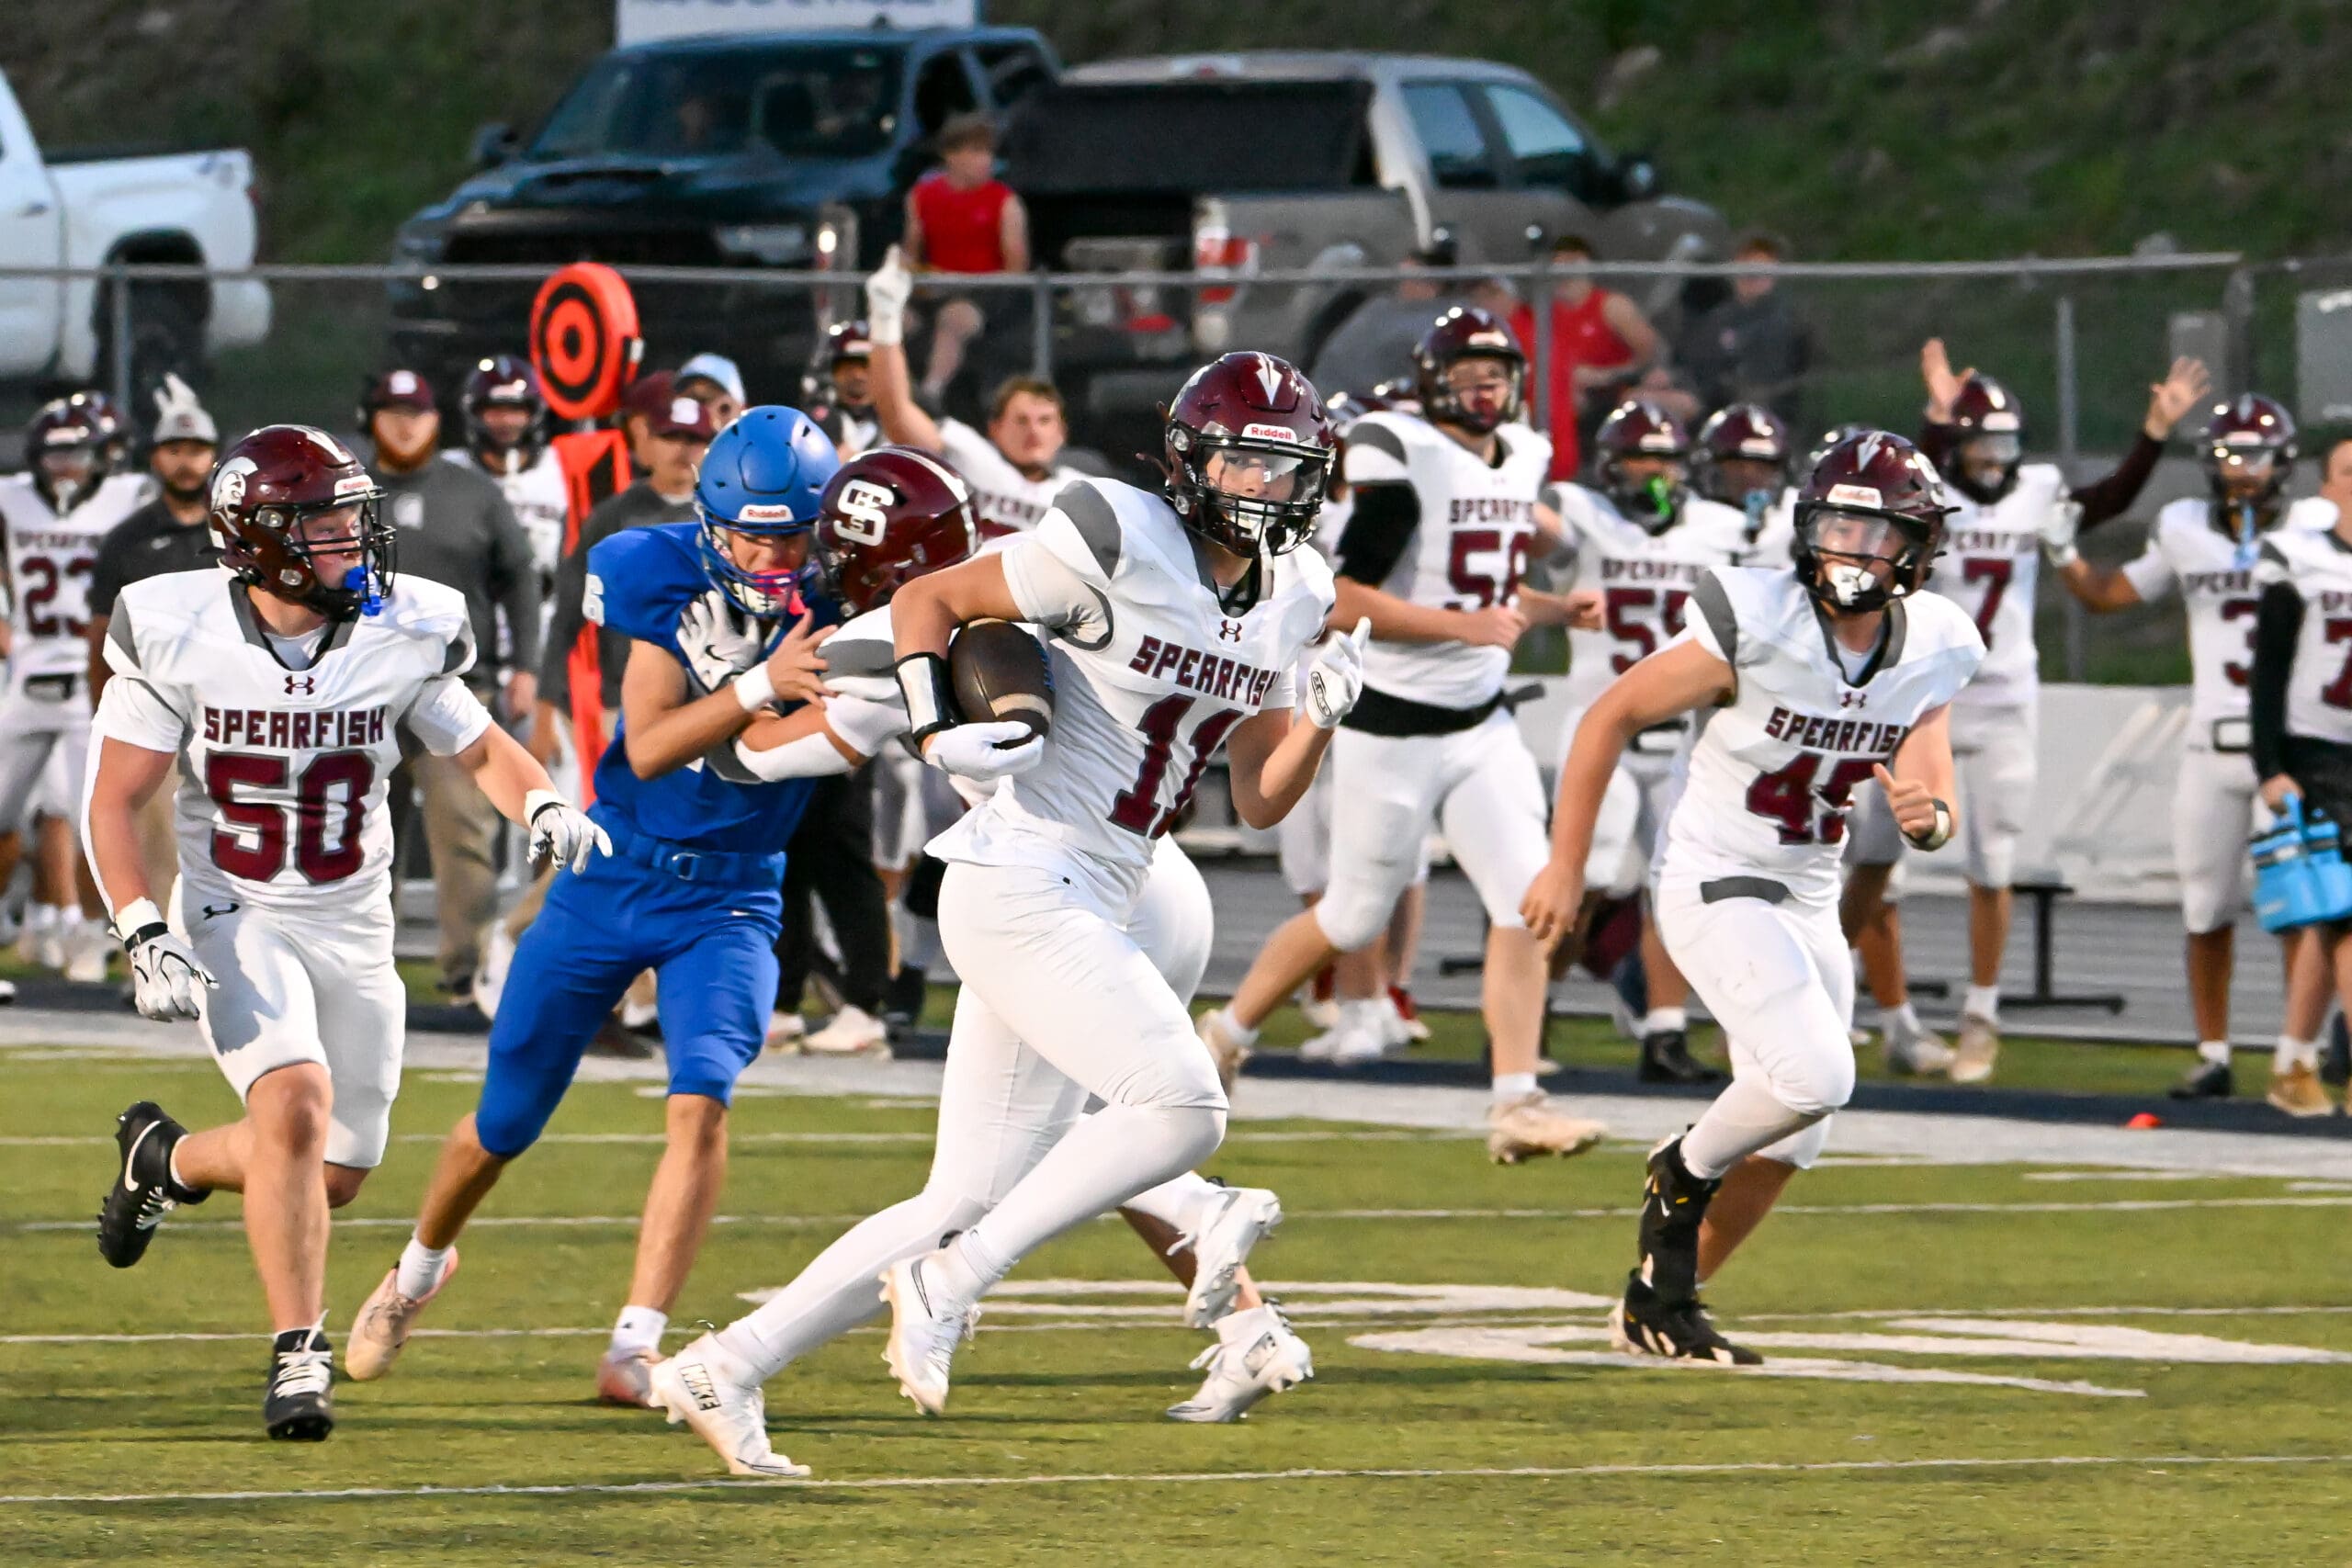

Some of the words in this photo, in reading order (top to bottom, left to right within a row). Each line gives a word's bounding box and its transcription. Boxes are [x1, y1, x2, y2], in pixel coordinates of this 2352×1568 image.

[1251, 426, 1292, 440] Riddell
[1962, 558, 2012, 652] 7
[204, 705, 385, 749] SPEARFISH
[1106, 693, 1244, 840] 11
[204, 748, 375, 885] 50
